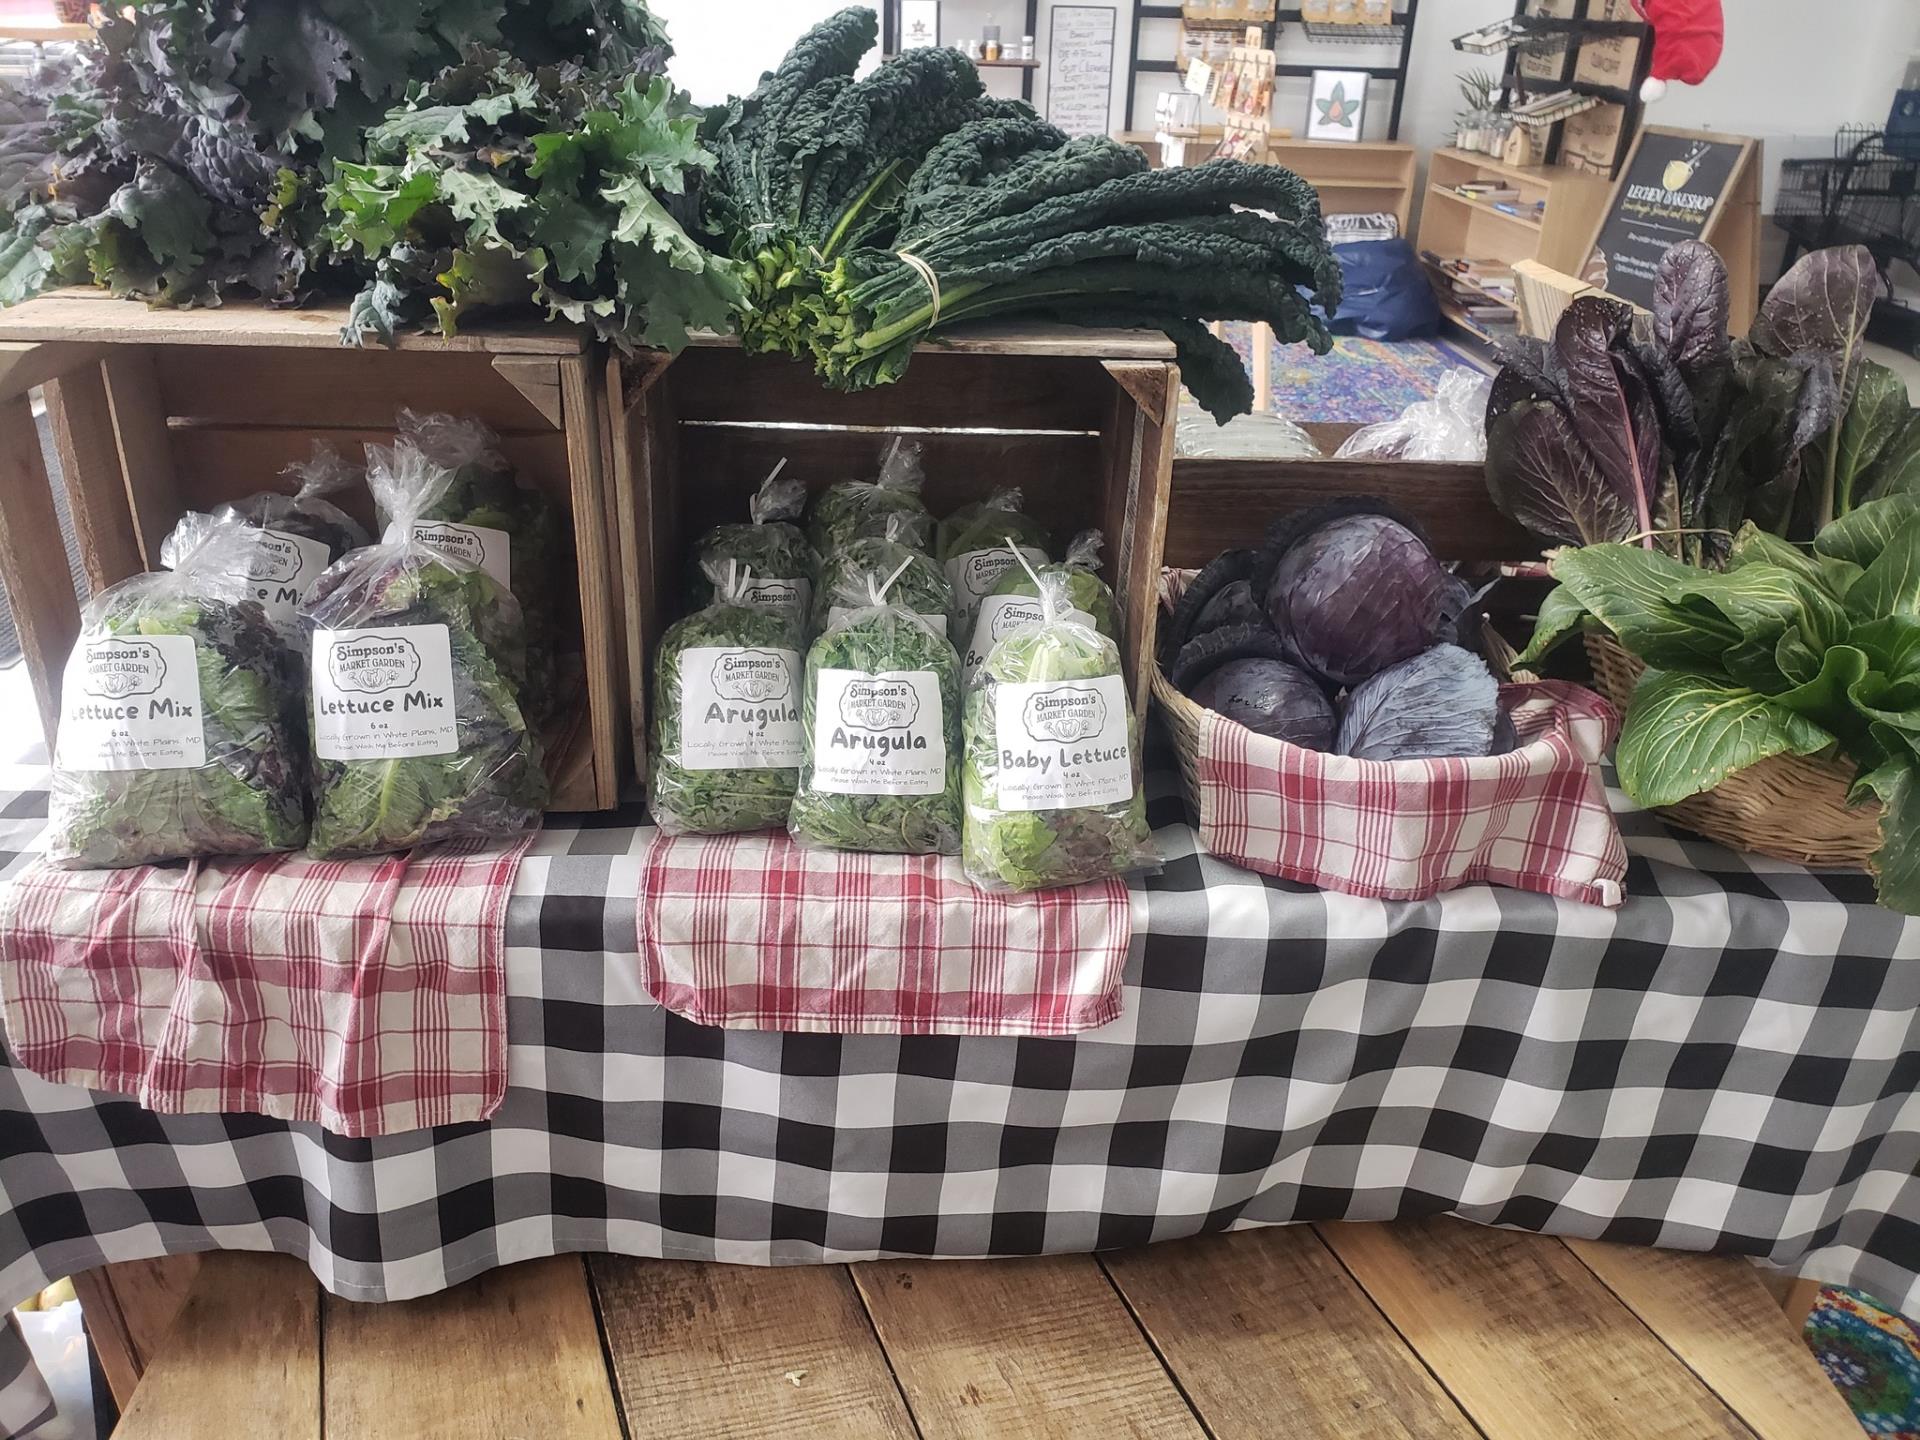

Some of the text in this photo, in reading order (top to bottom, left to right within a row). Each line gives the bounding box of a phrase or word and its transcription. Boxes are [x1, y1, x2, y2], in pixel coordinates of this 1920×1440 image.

[415, 531, 474, 545] Simpson's
[275, 587, 303, 606] Mi
[1004, 607, 1044, 621] Simpso
[87, 647, 150, 663] Simpson's
[337, 643, 405, 661] Simpson's
[114, 662, 149, 674] GARDEN
[340, 657, 405, 673] MARKET GARDEN
[724, 657, 780, 671] Simpson's
[726, 671, 780, 682] MARKET GARDEN
[850, 684, 907, 698] Simpson's
[148, 698, 193, 720] Mix
[320, 690, 444, 716] Lettuce Mix
[851, 699, 906, 710] MARKET GARDEN
[1035, 694, 1096, 711] Simpson's
[704, 702, 799, 730] Arugula
[1037, 708, 1096, 723] MARKET GARDEN
[111, 729, 117, 737] 6
[370, 722, 376, 730] 6
[383, 730, 408, 739] White
[440, 725, 454, 733] MD
[186, 736, 200, 745] MD
[830, 727, 927, 757] Arugula
[1002, 745, 1127, 775] Baby Lettuce
[840, 767, 868, 775] Grown
[880, 768, 902, 776] White
[930, 766, 942, 775] MD
[1032, 782, 1062, 791] Grown
